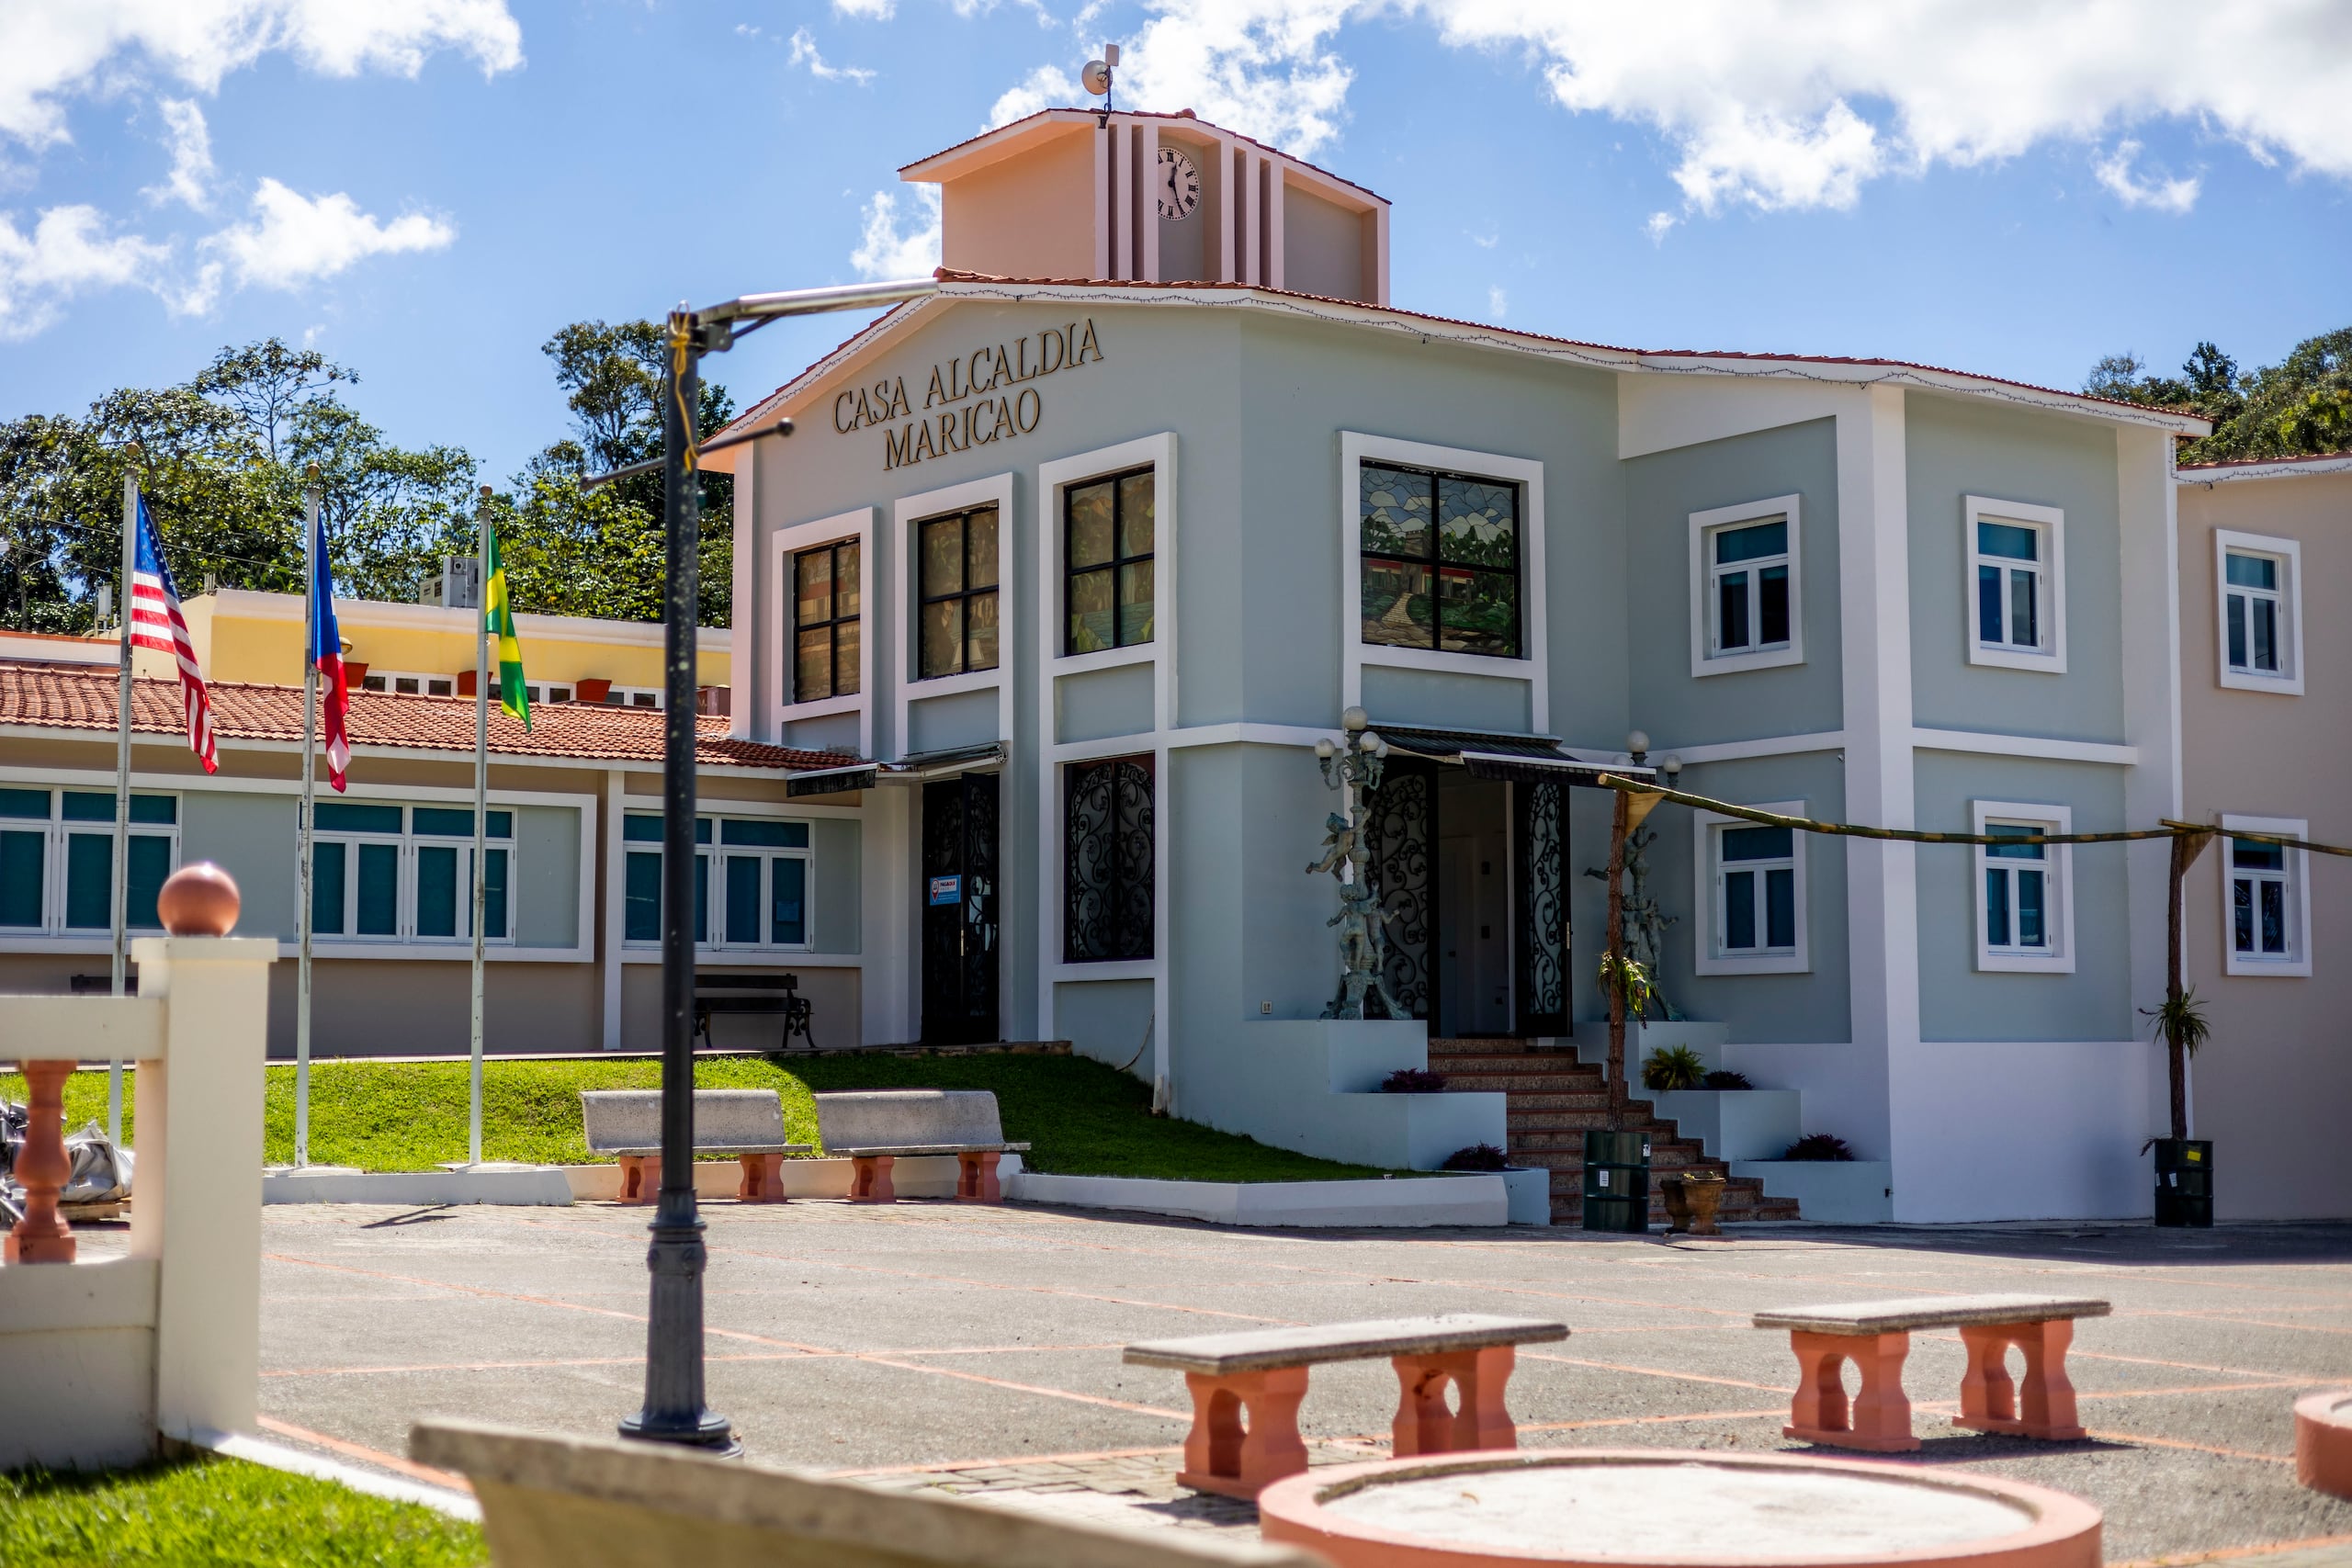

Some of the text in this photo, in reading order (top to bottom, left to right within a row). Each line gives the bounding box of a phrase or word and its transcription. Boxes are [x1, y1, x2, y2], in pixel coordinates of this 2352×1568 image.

[832, 318, 1104, 434] CASA ALCALDIA
[883, 388, 1041, 471] MARICAO
